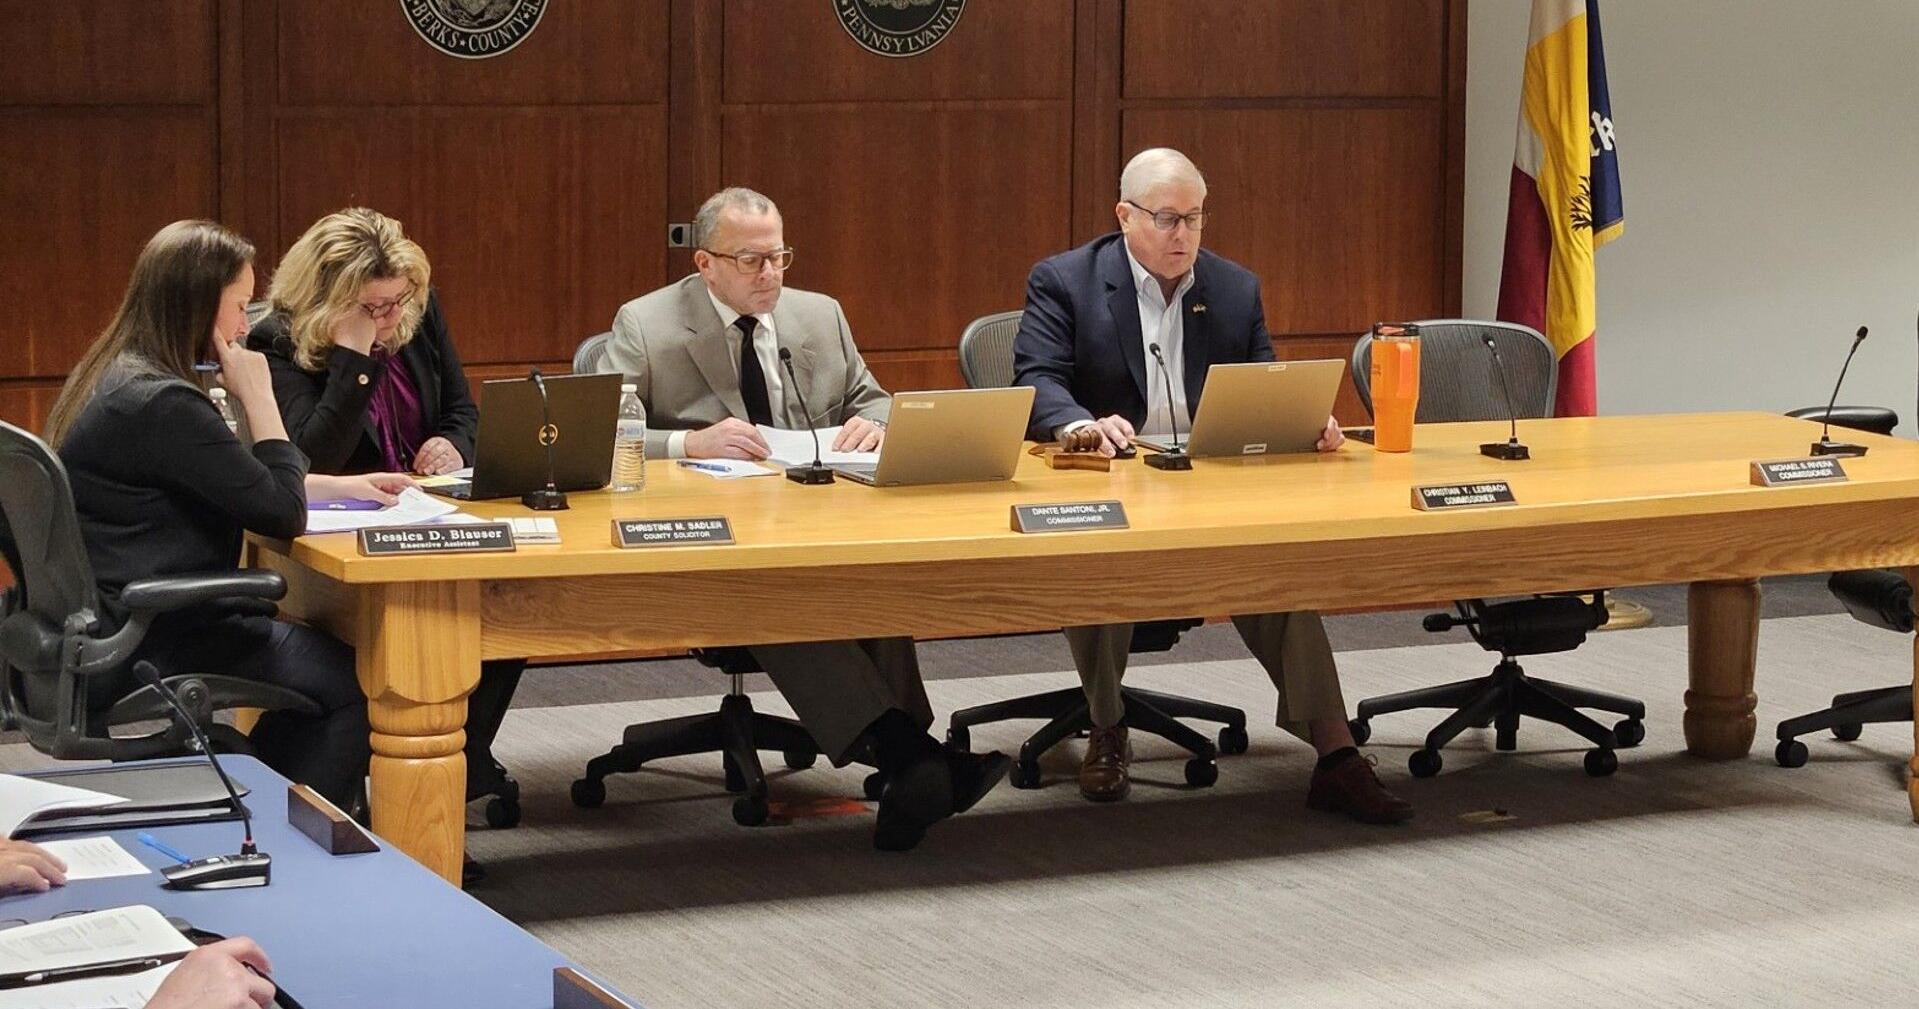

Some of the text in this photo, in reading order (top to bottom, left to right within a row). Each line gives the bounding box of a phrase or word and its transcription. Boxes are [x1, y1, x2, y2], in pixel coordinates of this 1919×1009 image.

[412, 2, 529, 52] BERKS COUNTY
[842, 5, 959, 52] PENNSYLVANIA
[1808, 460, 1834, 469] RIVERA
[1779, 468, 1833, 479] COMMISSIONER
[1423, 486, 1460, 497] CHRISTIAN
[1472, 484, 1508, 494] LEINBACH
[1444, 493, 1496, 505] COMMISSIONER
[1032, 507, 1059, 516] DANTE
[1098, 504, 1111, 513] JR.
[1046, 515, 1103, 525] COMMISSIONER
[625, 520, 723, 533] CHRISTINE M. SADLER
[374, 531, 424, 543] Jessica
[429, 530, 446, 541] D.
[450, 528, 503, 540] Blauser
[643, 530, 711, 541] COUNTY SOLICITOR
[400, 540, 480, 550] Executive Assistant
